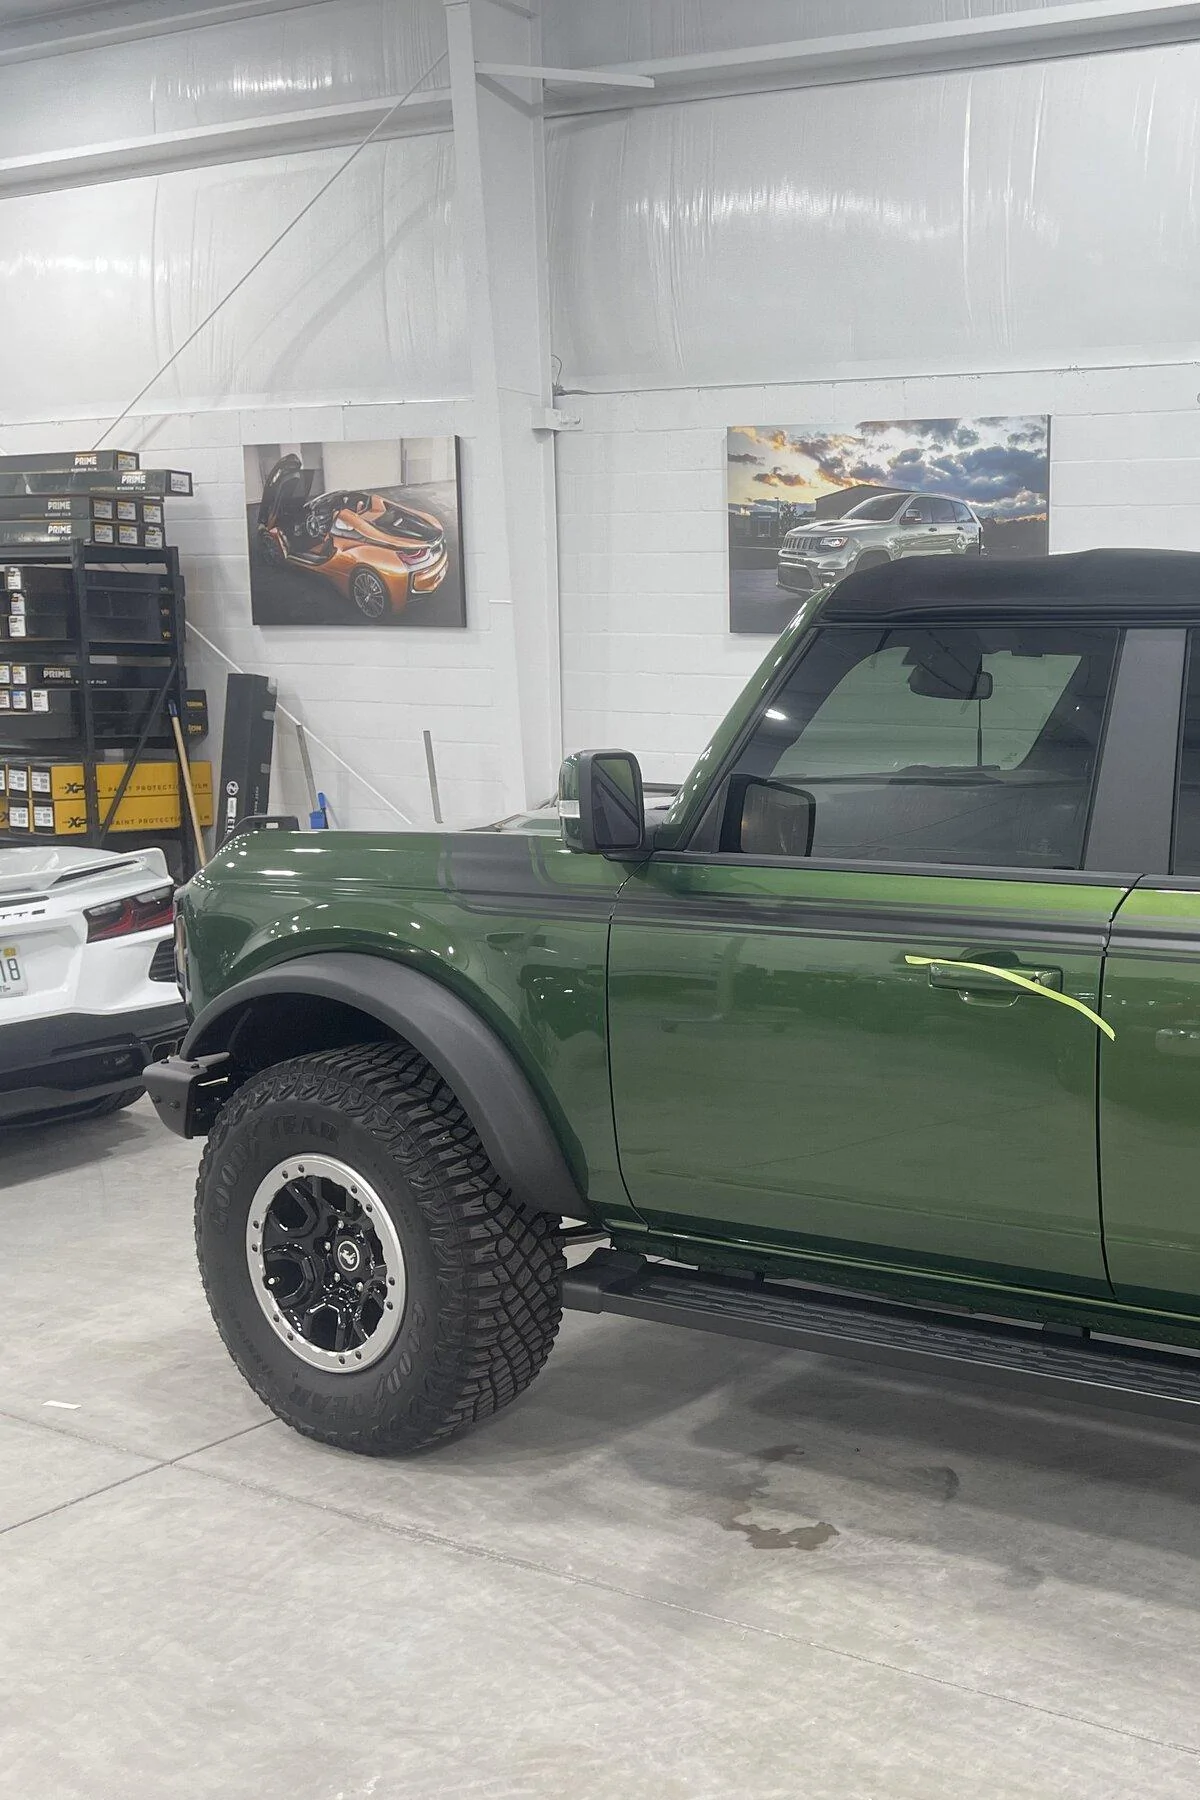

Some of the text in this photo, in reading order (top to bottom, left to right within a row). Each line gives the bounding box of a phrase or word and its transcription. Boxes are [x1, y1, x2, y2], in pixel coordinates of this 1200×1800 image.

[74, 456, 97, 466] PRIME
[121, 475, 146, 484] PRIME
[47, 501, 71, 510] PRIME
[47, 525, 72, 534] PRIME
[43, 670, 71, 678] PRIME
[136, 782, 180, 791] PROTECTI
[138, 816, 180, 825] PROTECTI
